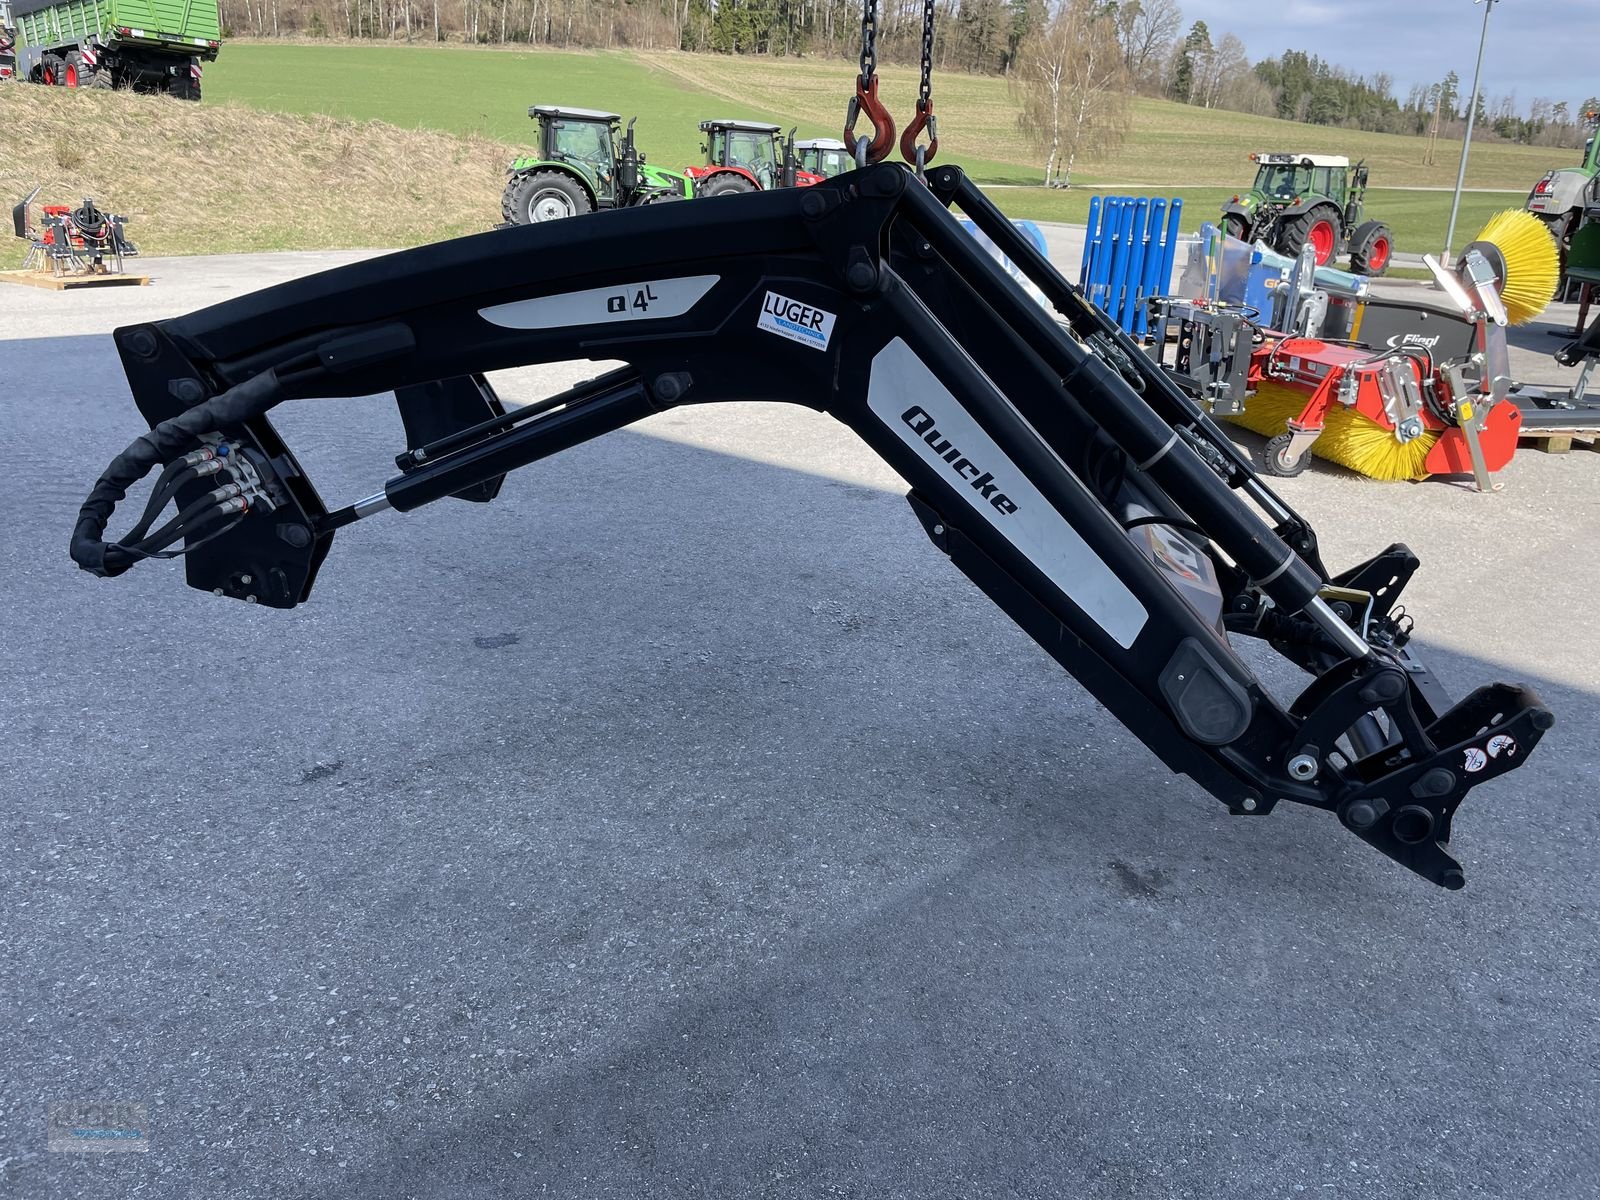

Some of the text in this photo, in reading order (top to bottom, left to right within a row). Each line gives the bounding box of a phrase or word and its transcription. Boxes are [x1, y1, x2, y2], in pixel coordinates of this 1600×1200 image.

[763, 293, 825, 332] LUGER
[1402, 334, 1440, 348] Fliegl
[901, 405, 1018, 515] Quicke
